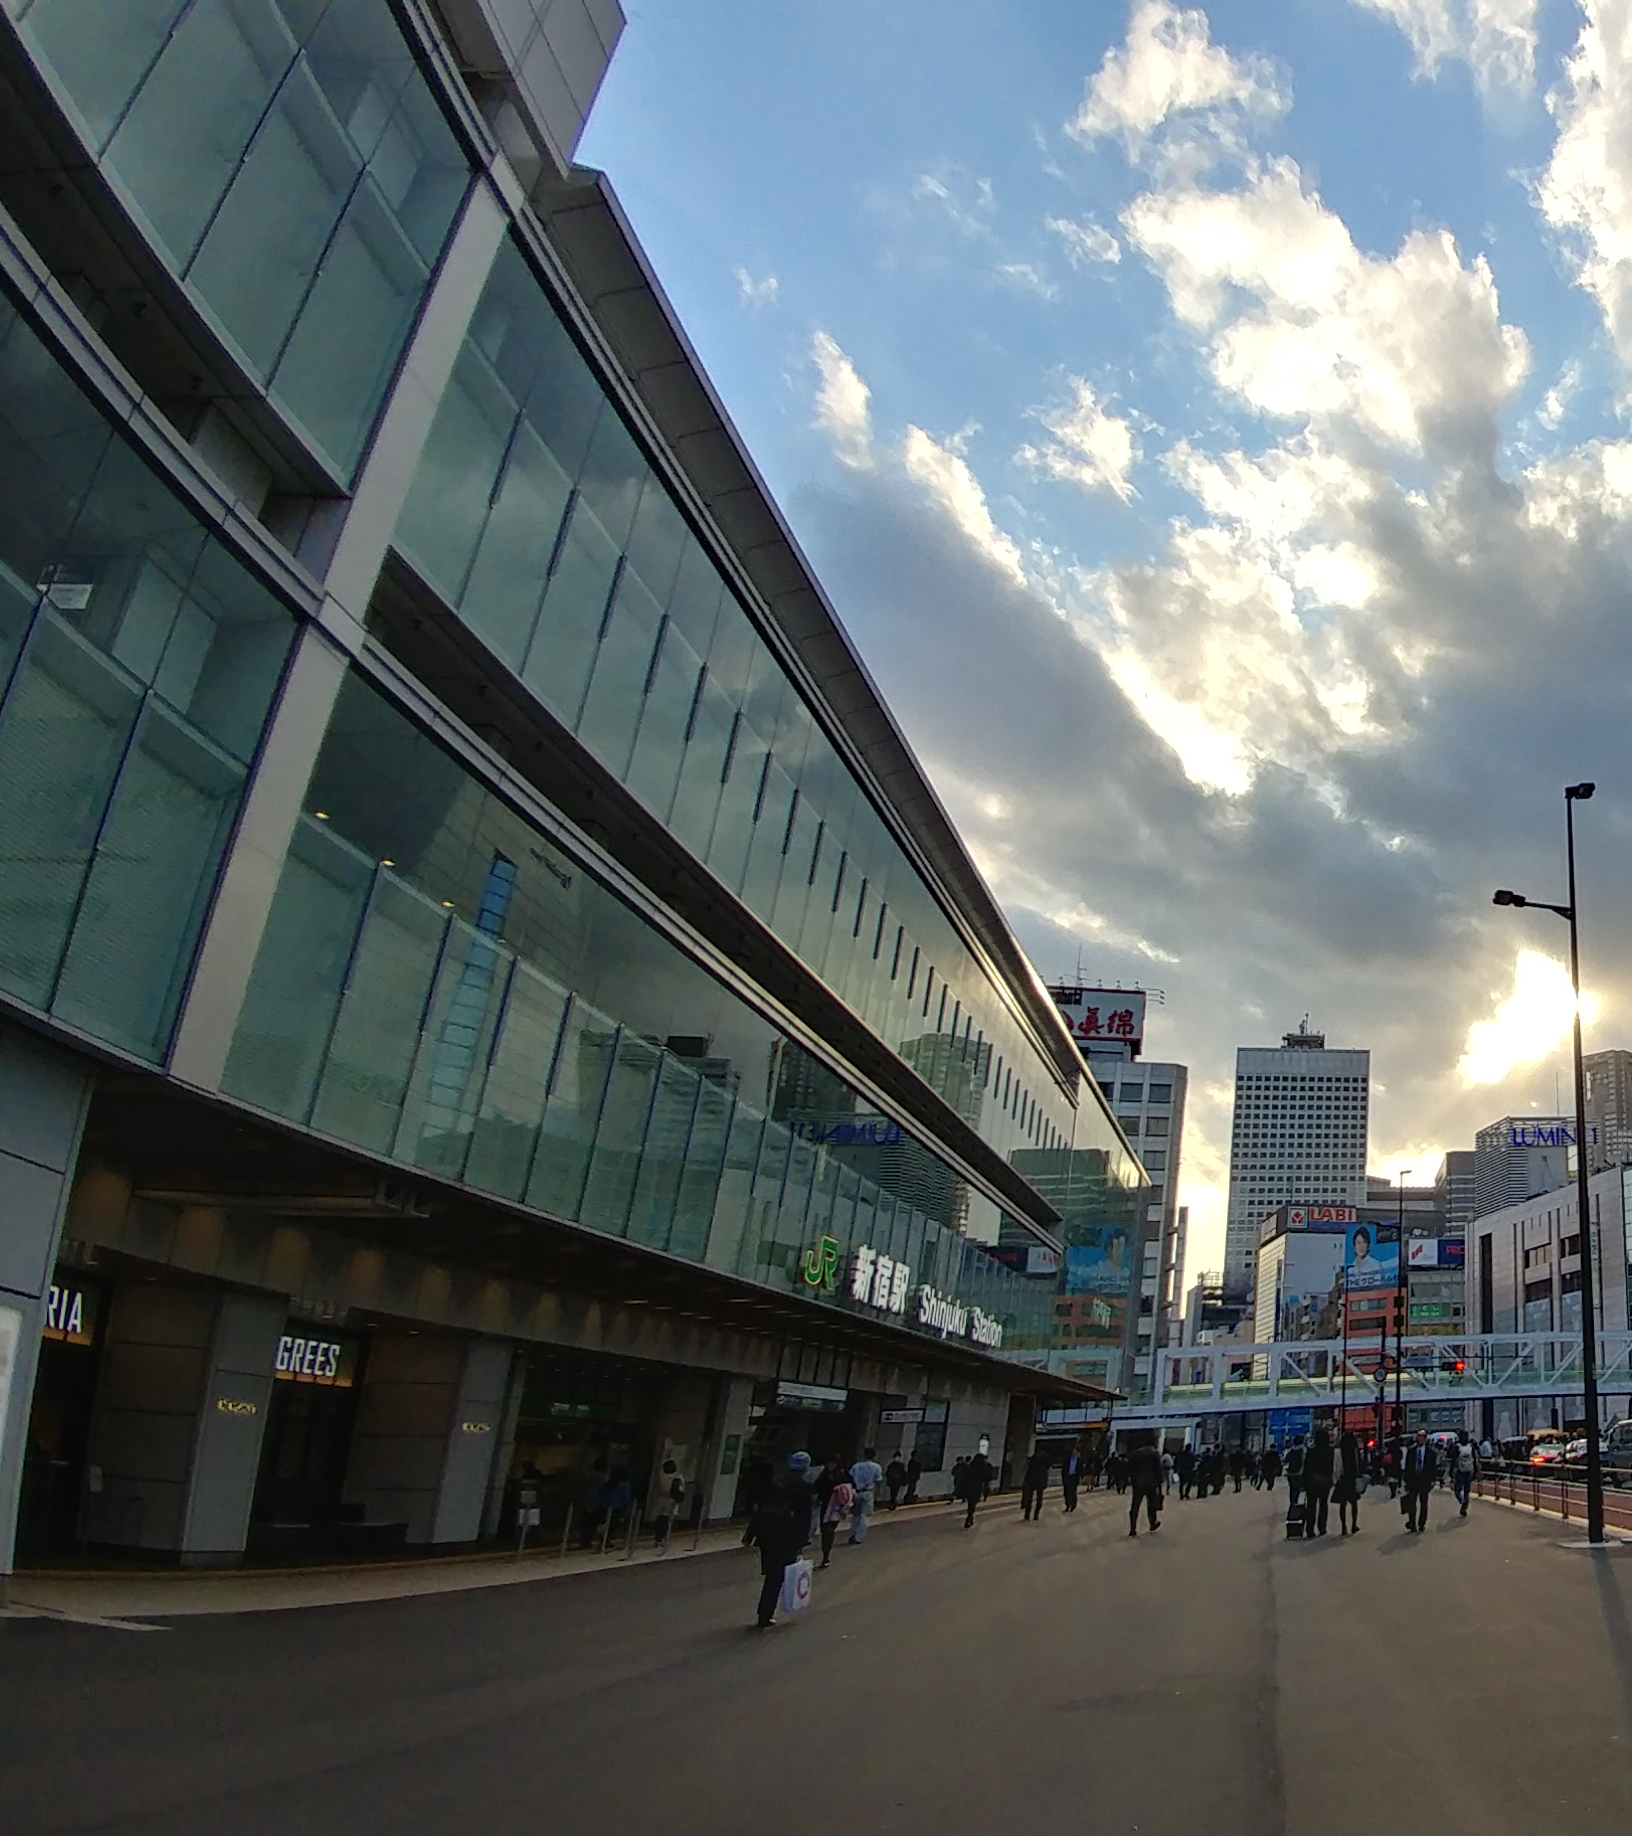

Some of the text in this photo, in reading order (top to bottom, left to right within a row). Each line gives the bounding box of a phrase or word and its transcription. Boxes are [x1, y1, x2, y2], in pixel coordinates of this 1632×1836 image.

[1511, 1127, 1577, 1146] LUMIN
[1309, 1206, 1355, 1223] LABI
[804, 1234, 1004, 1349] JR 新宿駅 Shinjuku Station
[275, 1335, 341, 1377] GREES
